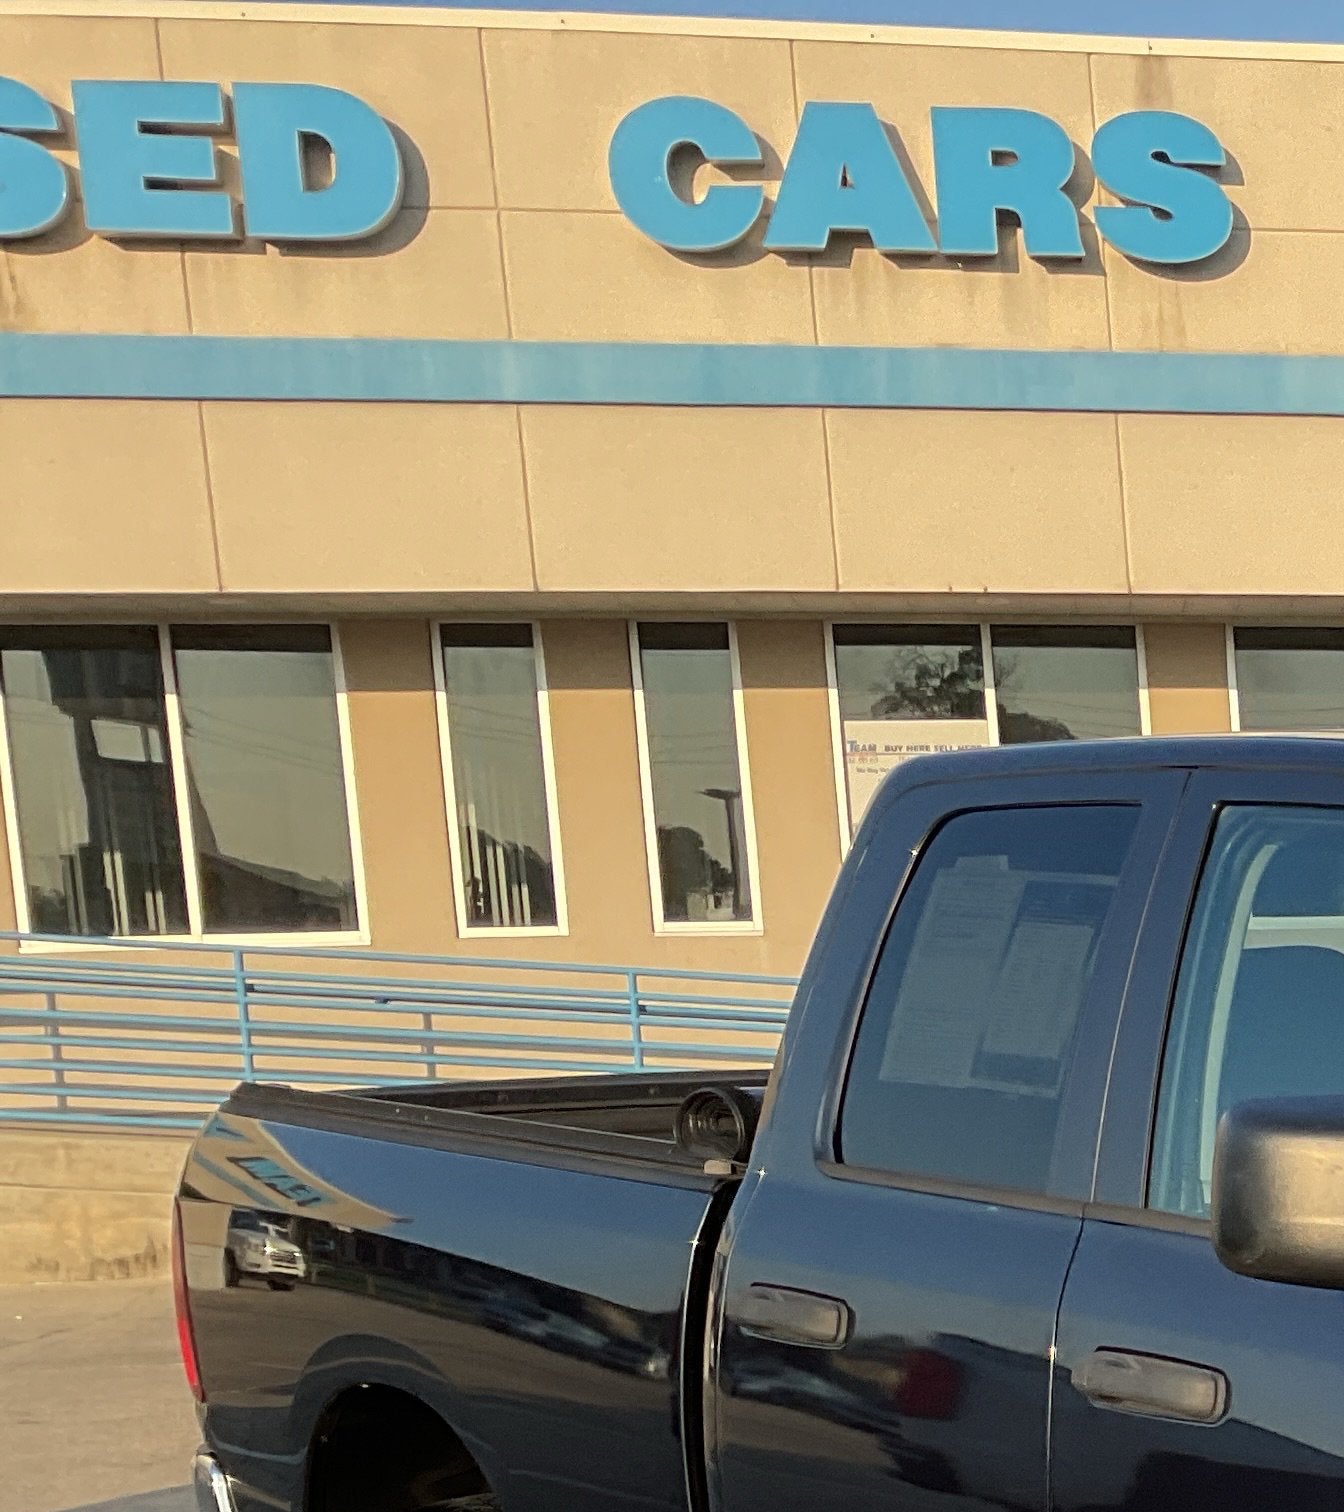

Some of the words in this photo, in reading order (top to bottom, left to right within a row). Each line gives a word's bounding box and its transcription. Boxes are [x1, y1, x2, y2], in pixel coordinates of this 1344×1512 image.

[608, 94, 1234, 265] CARS
[884, 744, 904, 752] BUY
[905, 744, 931, 752] HERE
